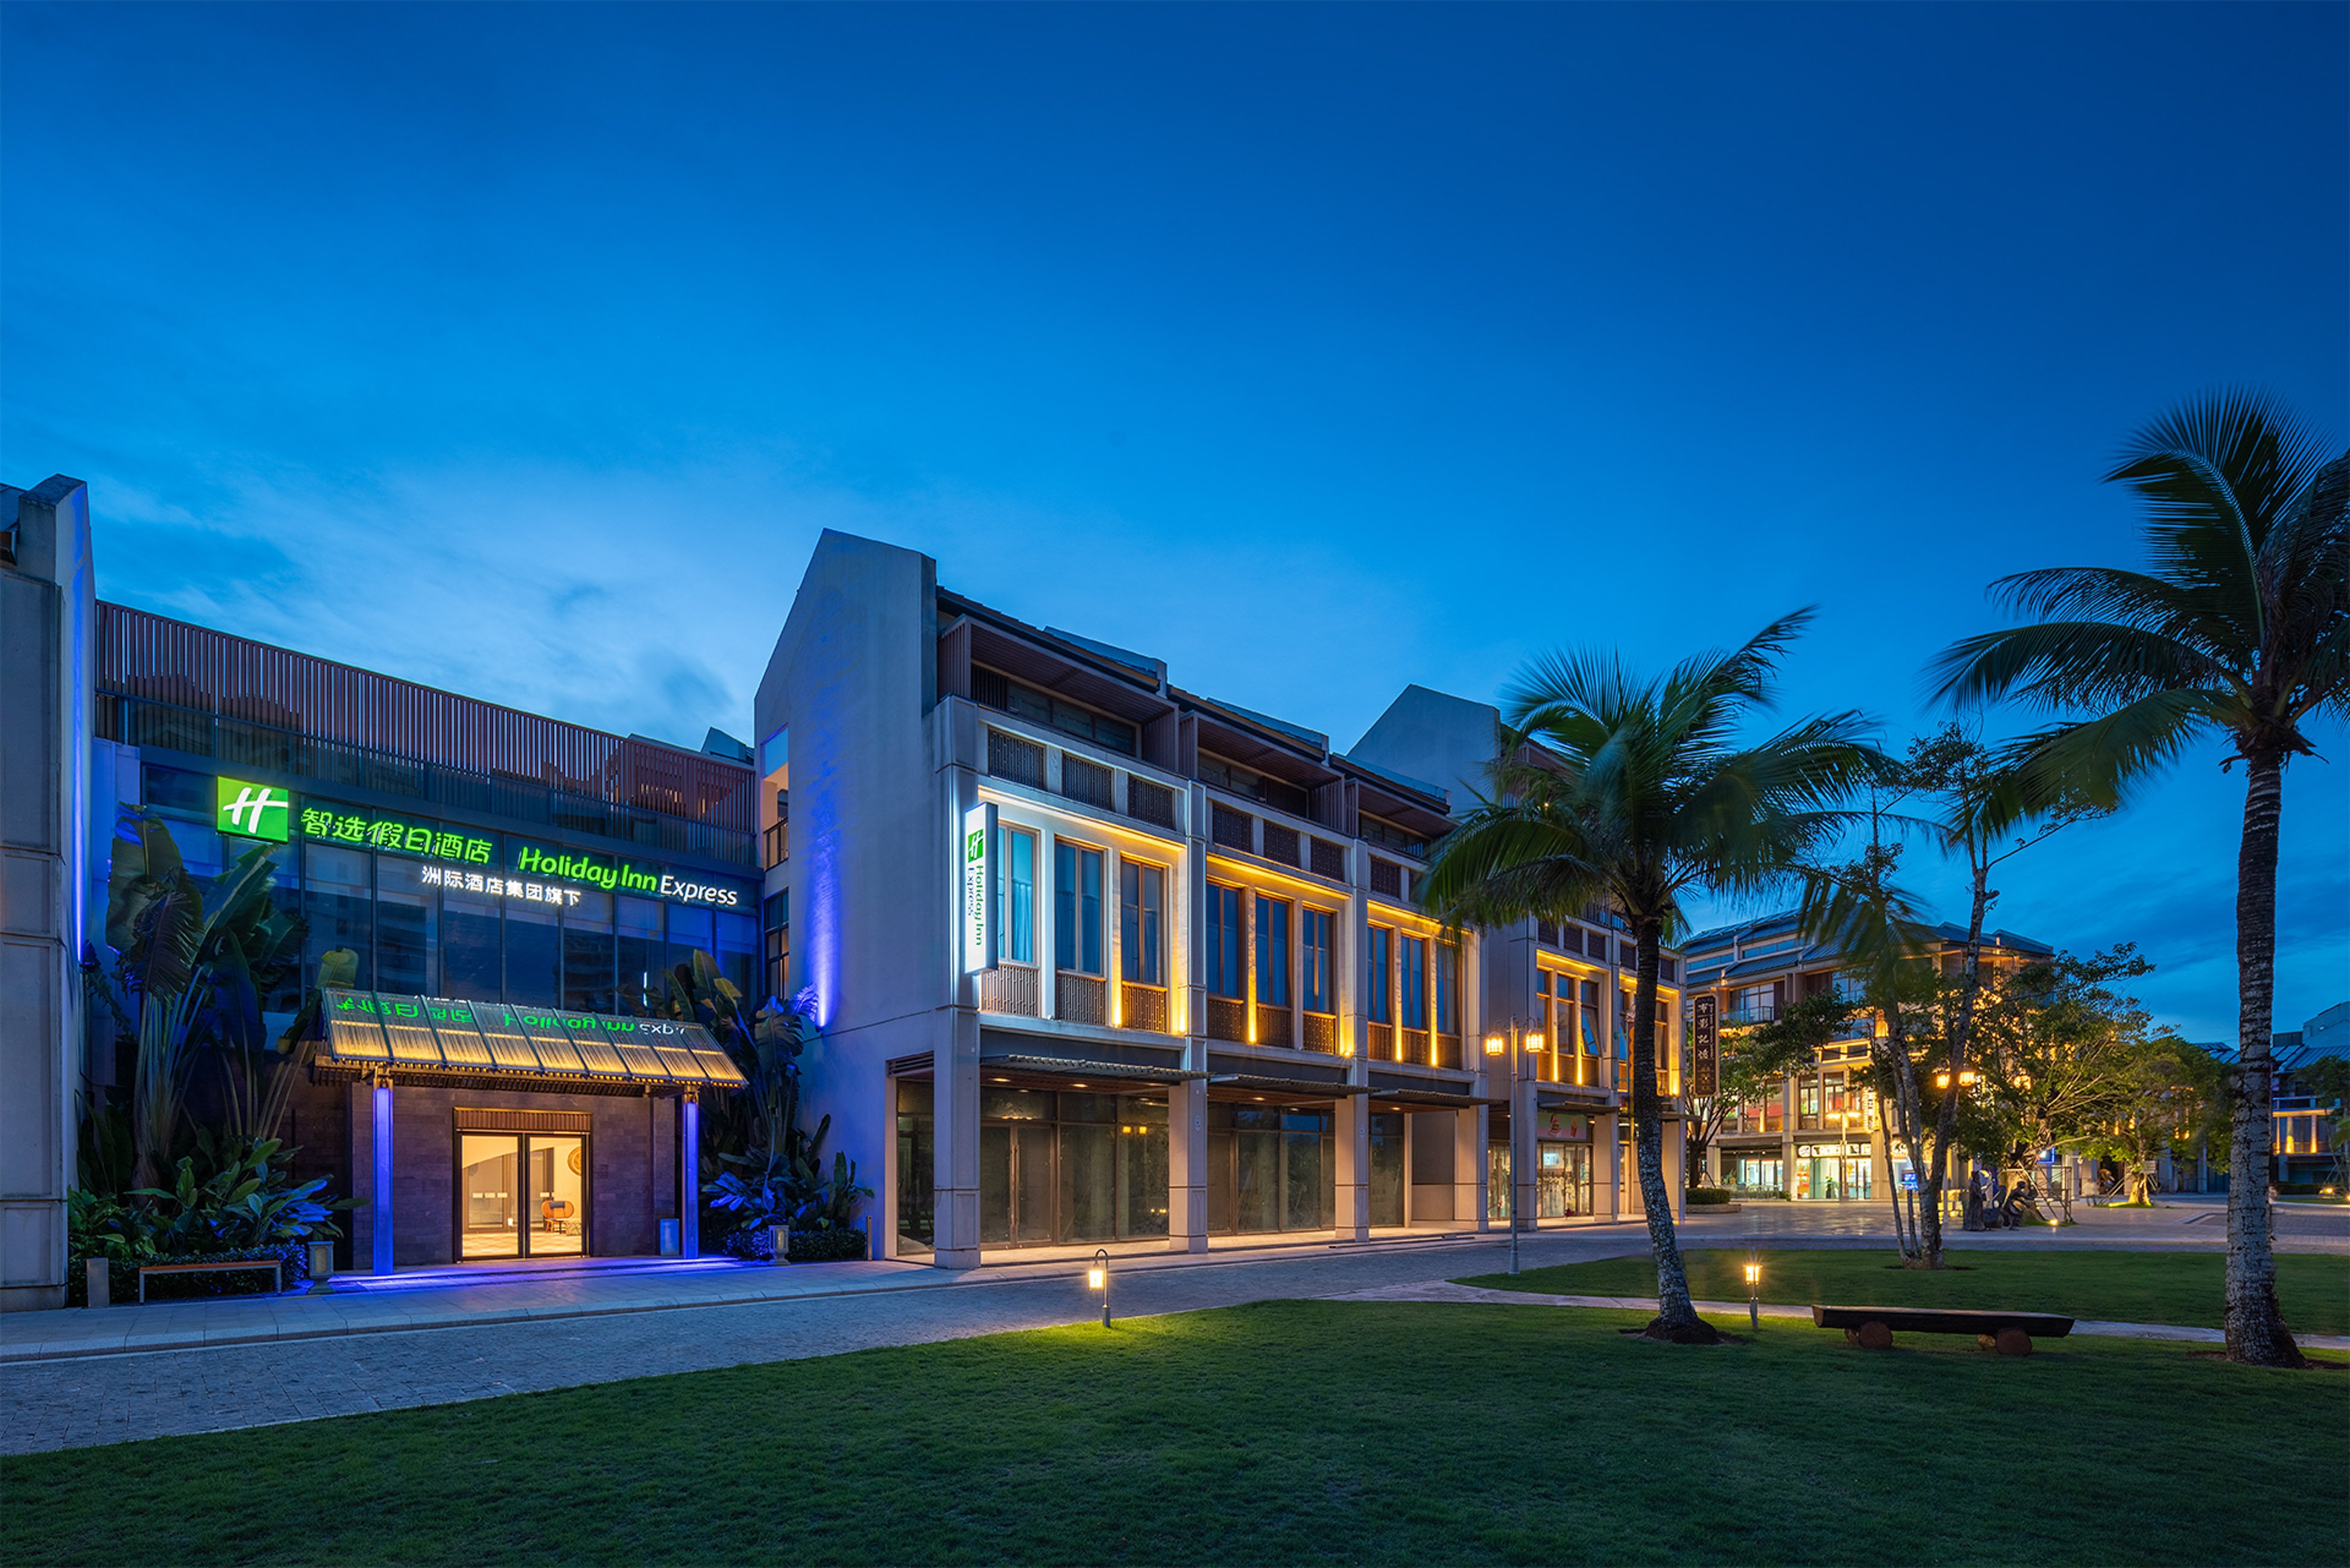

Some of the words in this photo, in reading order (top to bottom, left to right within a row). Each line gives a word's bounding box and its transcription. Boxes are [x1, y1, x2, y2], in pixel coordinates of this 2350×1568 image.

[301, 807, 493, 864] 智选假日酒店
[422, 865, 581, 906] 洲际酒店集团旗下
[519, 841, 618, 889] Holiday
[621, 865, 657, 891] Inn
[660, 875, 738, 905] Express
[974, 865, 984, 920] Holiday
